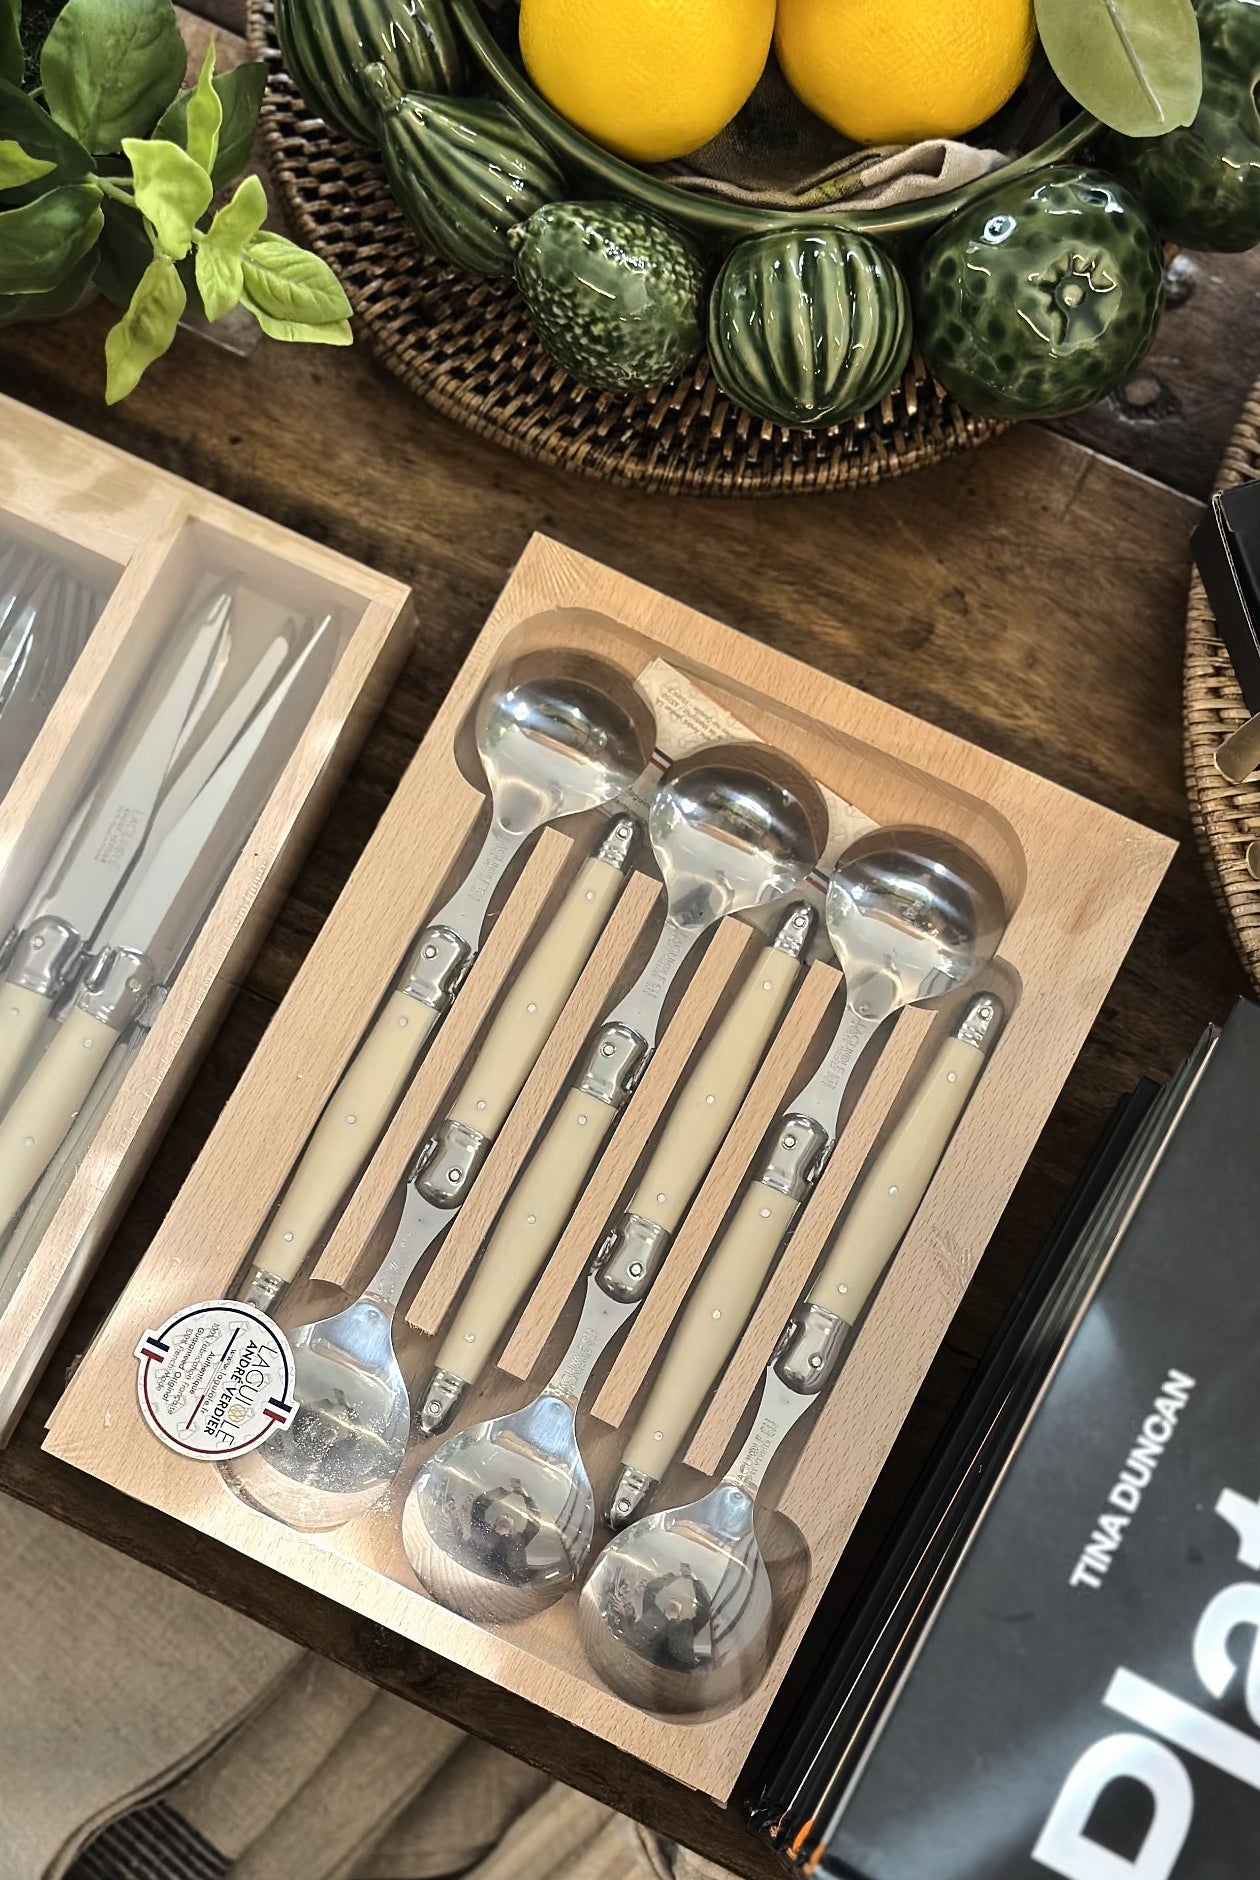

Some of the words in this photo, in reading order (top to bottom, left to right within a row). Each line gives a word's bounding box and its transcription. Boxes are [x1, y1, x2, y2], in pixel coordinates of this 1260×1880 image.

[178, 1327, 205, 1371] Guaranteed
[183, 1328, 194, 1345] 100%
[170, 1345, 185, 1371] French
[186, 1340, 211, 1381] Fabrication
[189, 1351, 216, 1395] Authentique
[230, 1339, 259, 1385] ANDRÉ
[157, 1371, 171, 1392] Made
[162, 1371, 182, 1402] Original
[168, 1381, 190, 1415] Française
[215, 1344, 278, 1446] LAGUIOLE
[203, 1386, 237, 1436] VERDIER
[1069, 1511, 1131, 1590] TINA
[1109, 1367, 1197, 1514] DUNCAN
